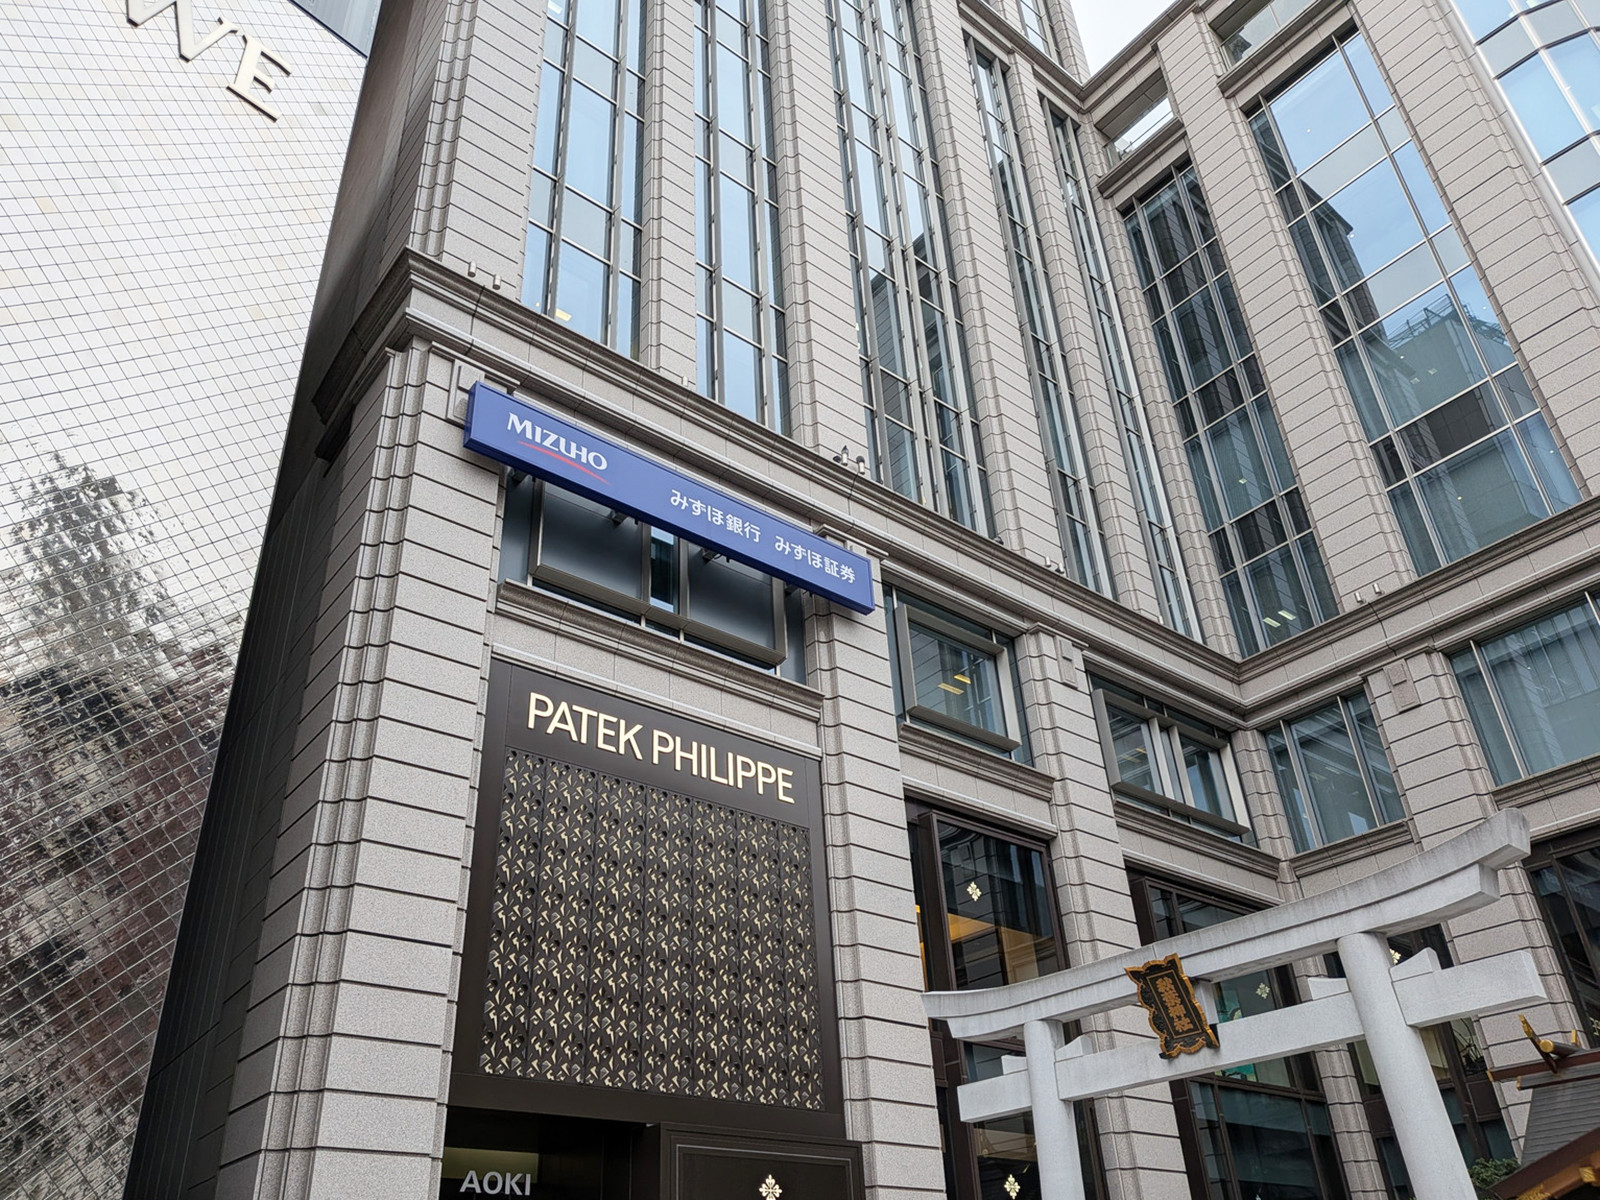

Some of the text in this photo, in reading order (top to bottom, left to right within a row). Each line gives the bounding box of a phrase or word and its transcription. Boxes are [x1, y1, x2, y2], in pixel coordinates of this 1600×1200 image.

[507, 411, 608, 471] MIZUHO
[669, 488, 856, 585] みずほ銀行 みずほ証券
[527, 692, 795, 804] PATEK PHILIPPE
[459, 1169, 531, 1196] AOKI
